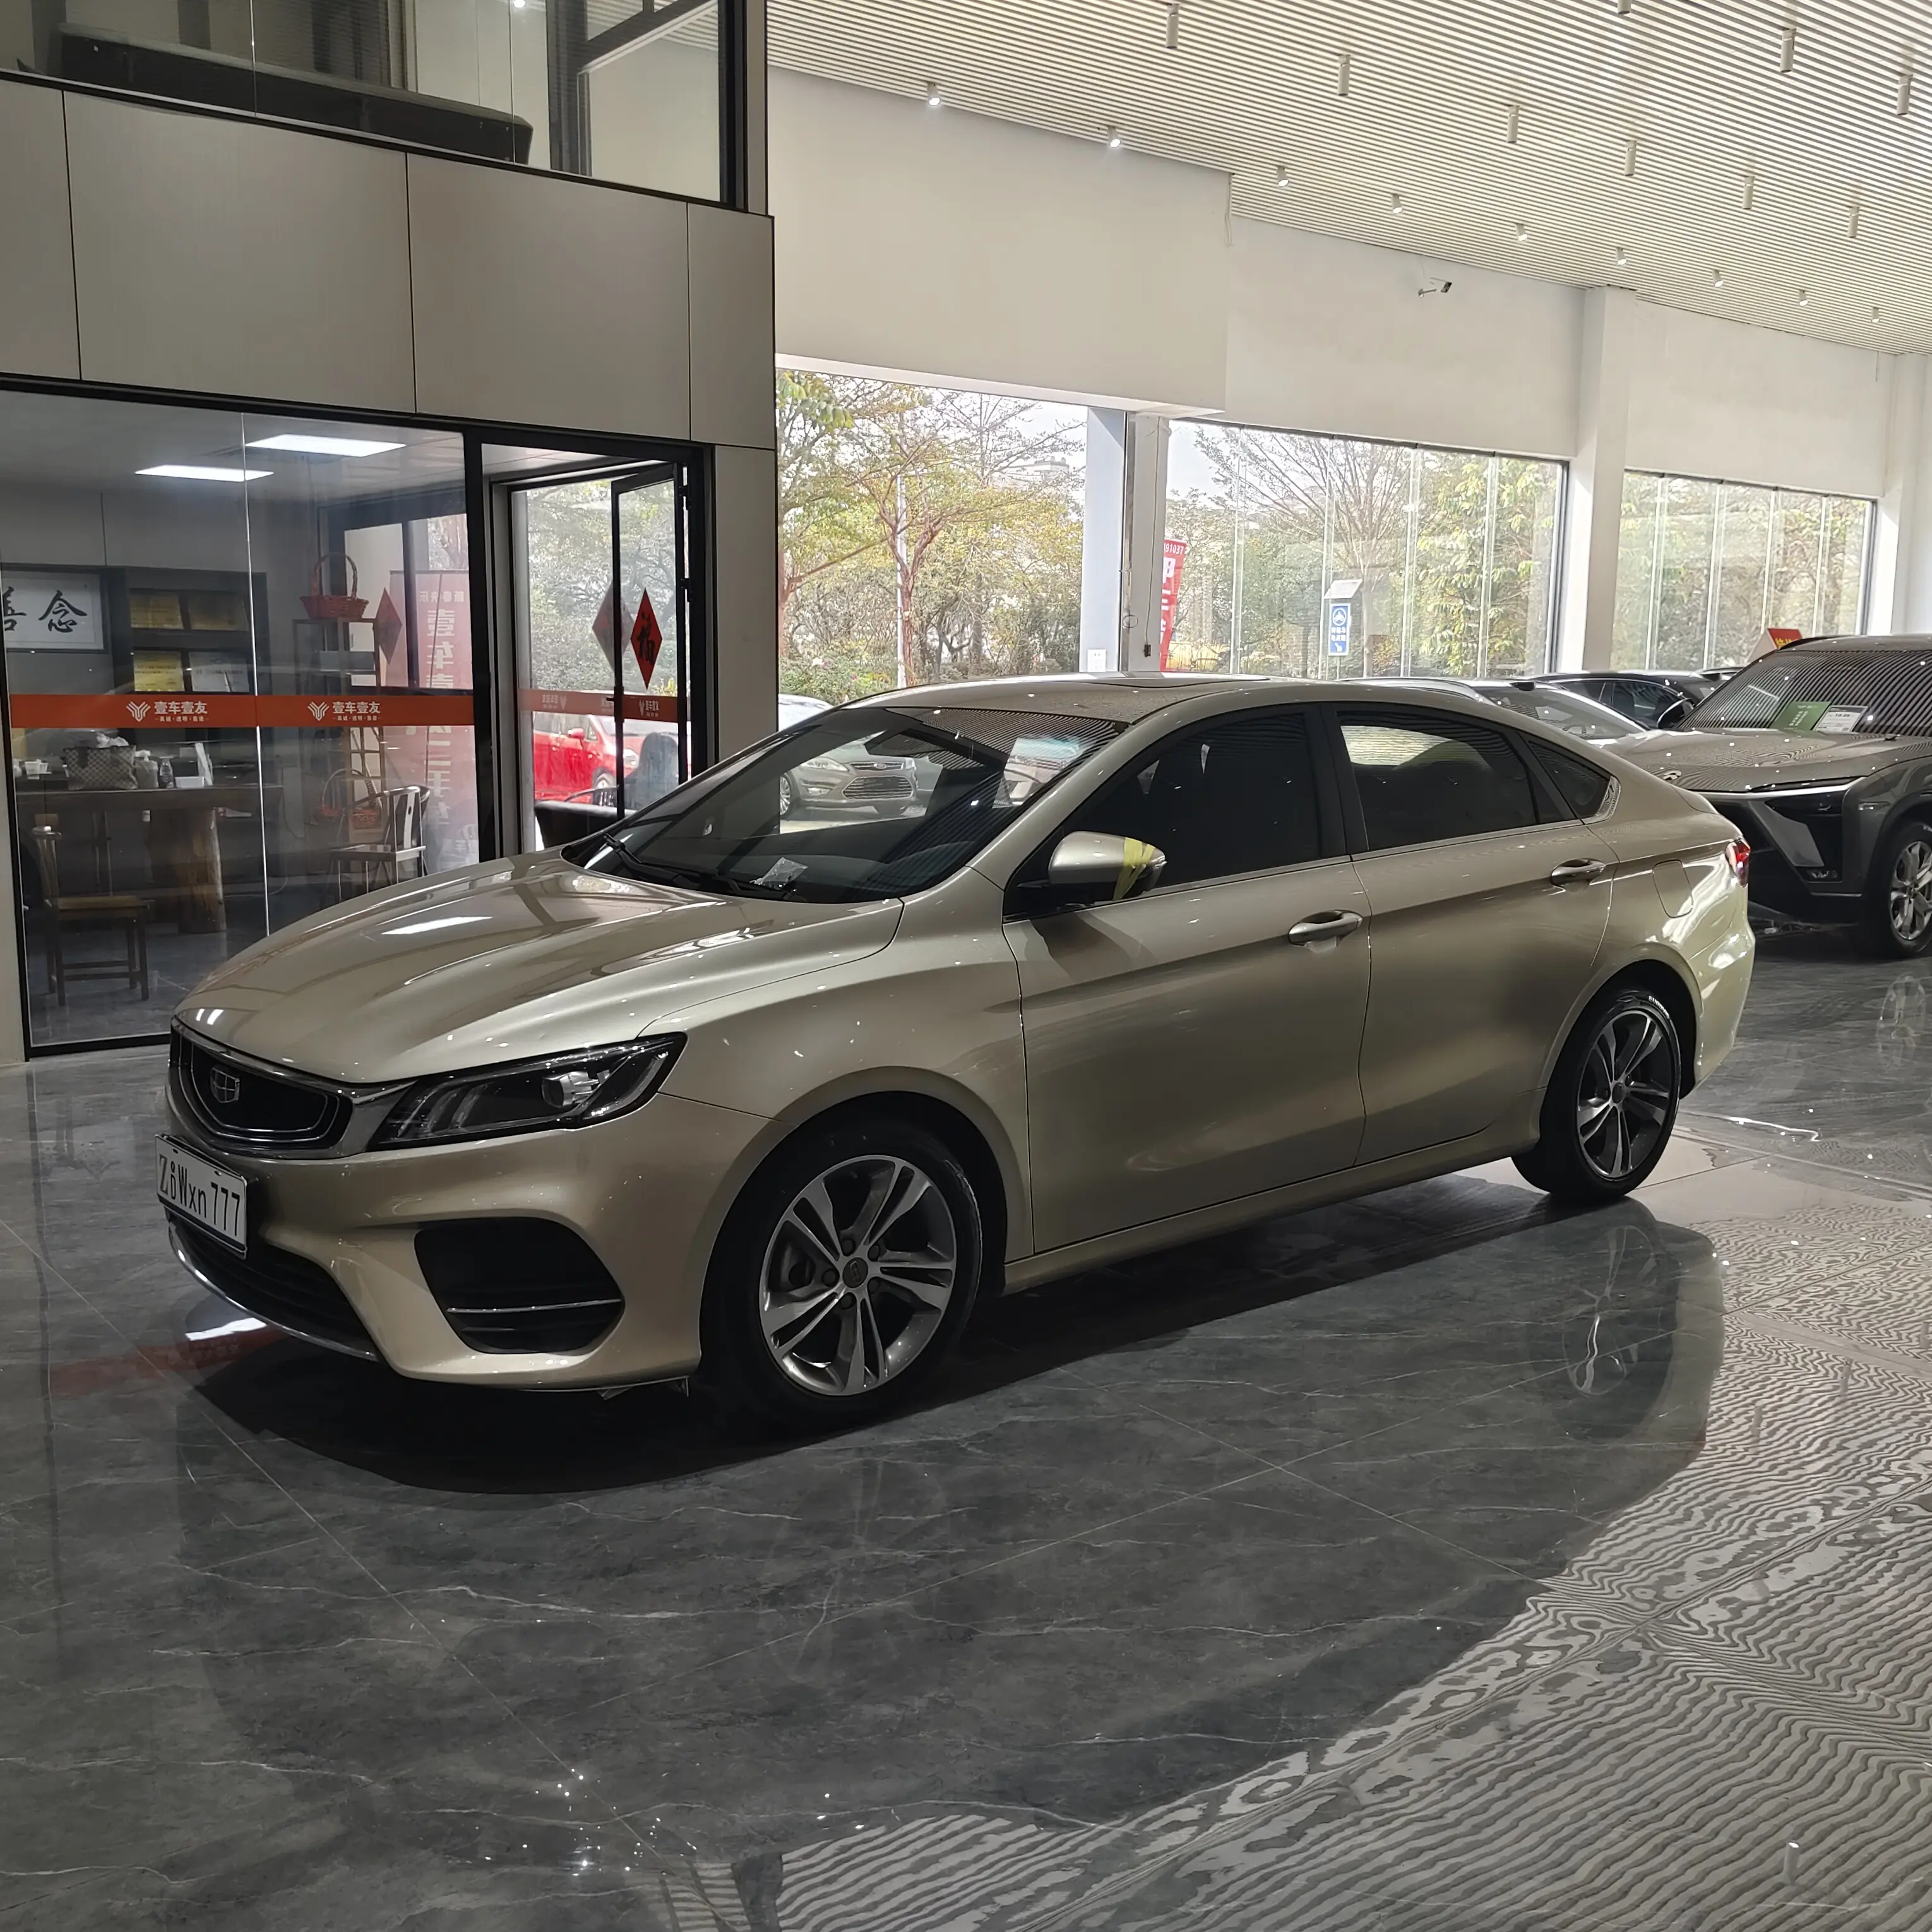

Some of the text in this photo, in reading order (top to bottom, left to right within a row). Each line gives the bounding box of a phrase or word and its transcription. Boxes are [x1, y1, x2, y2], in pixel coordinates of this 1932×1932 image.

[154, 701, 208, 715] 壹车壹友
[332, 701, 381, 714] 壹车壹友
